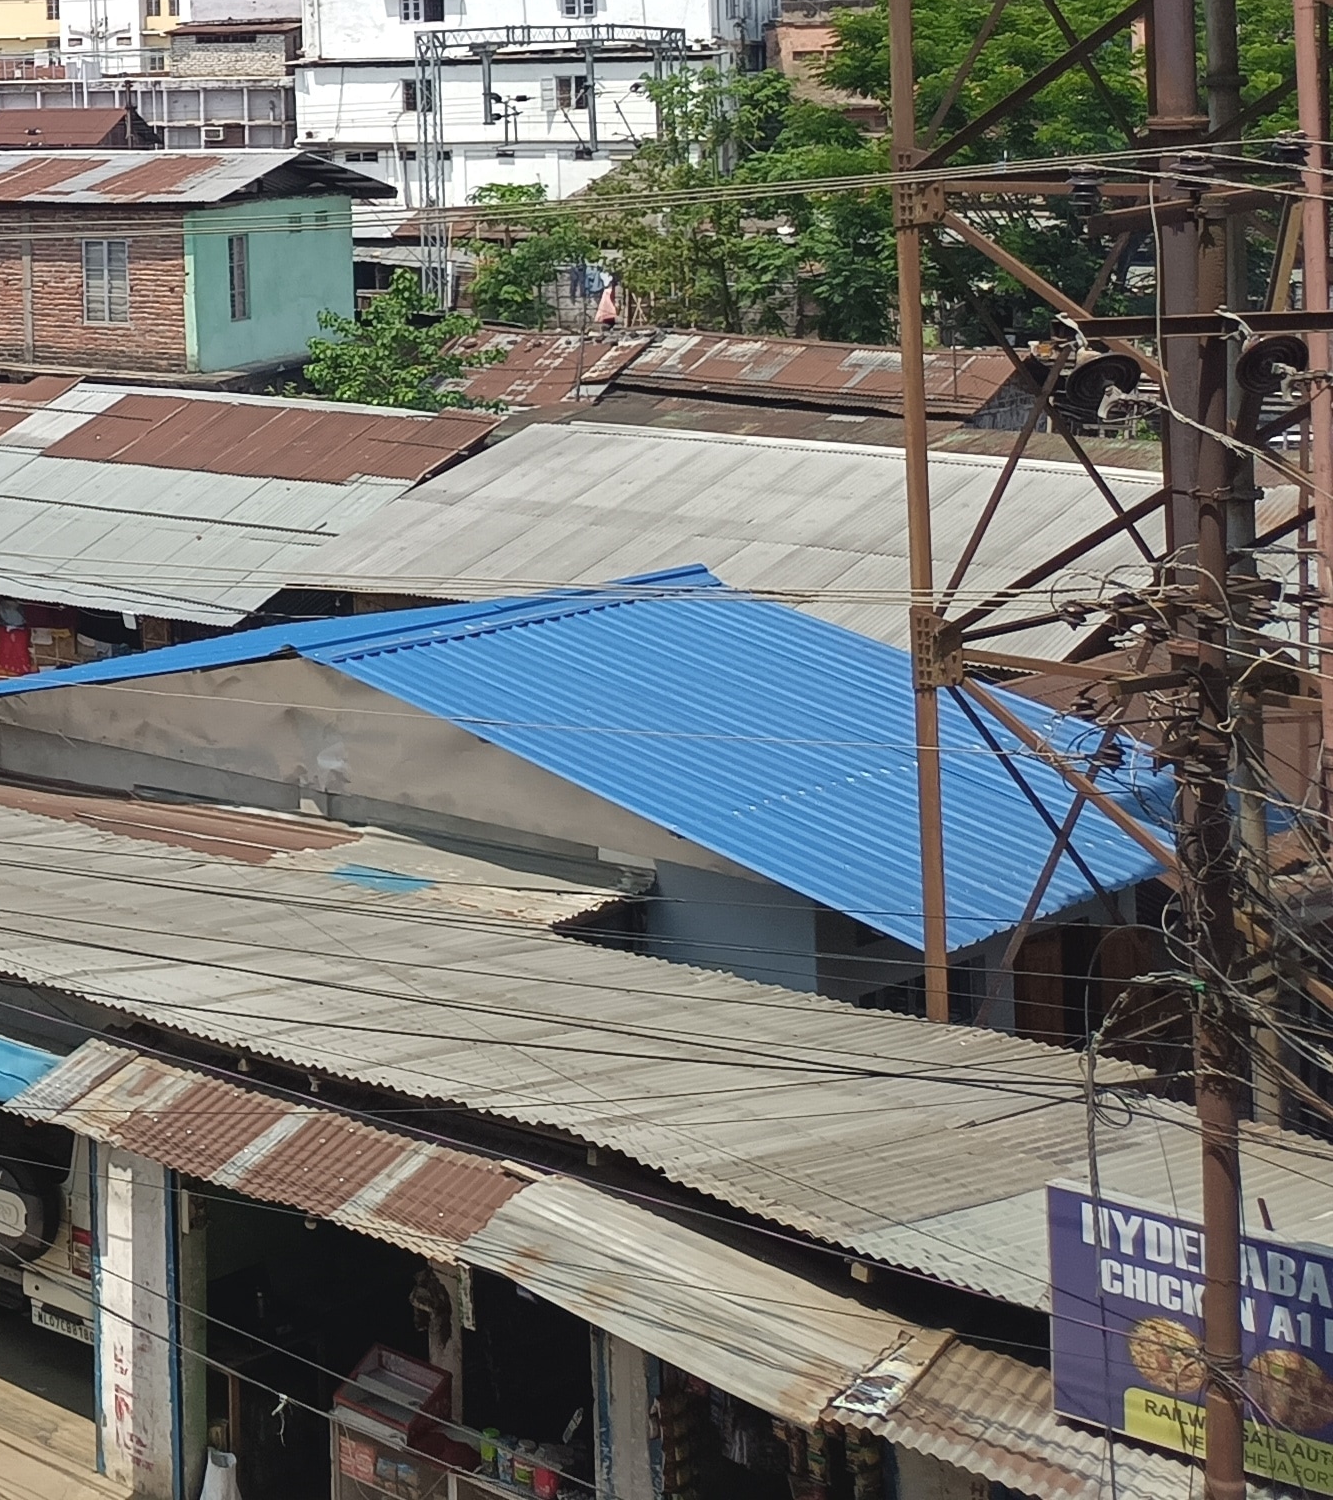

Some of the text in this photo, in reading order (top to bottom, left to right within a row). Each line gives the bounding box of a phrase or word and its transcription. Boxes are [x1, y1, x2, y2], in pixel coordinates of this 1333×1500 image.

[1081, 1201, 1333, 1309] HYDEABA
[1100, 1258, 1256, 1333] CHICKN
[1268, 1305, 1312, 1349] A1
[1244, 1450, 1289, 1475] HEJA
[1292, 1443, 1333, 1466] AUT
